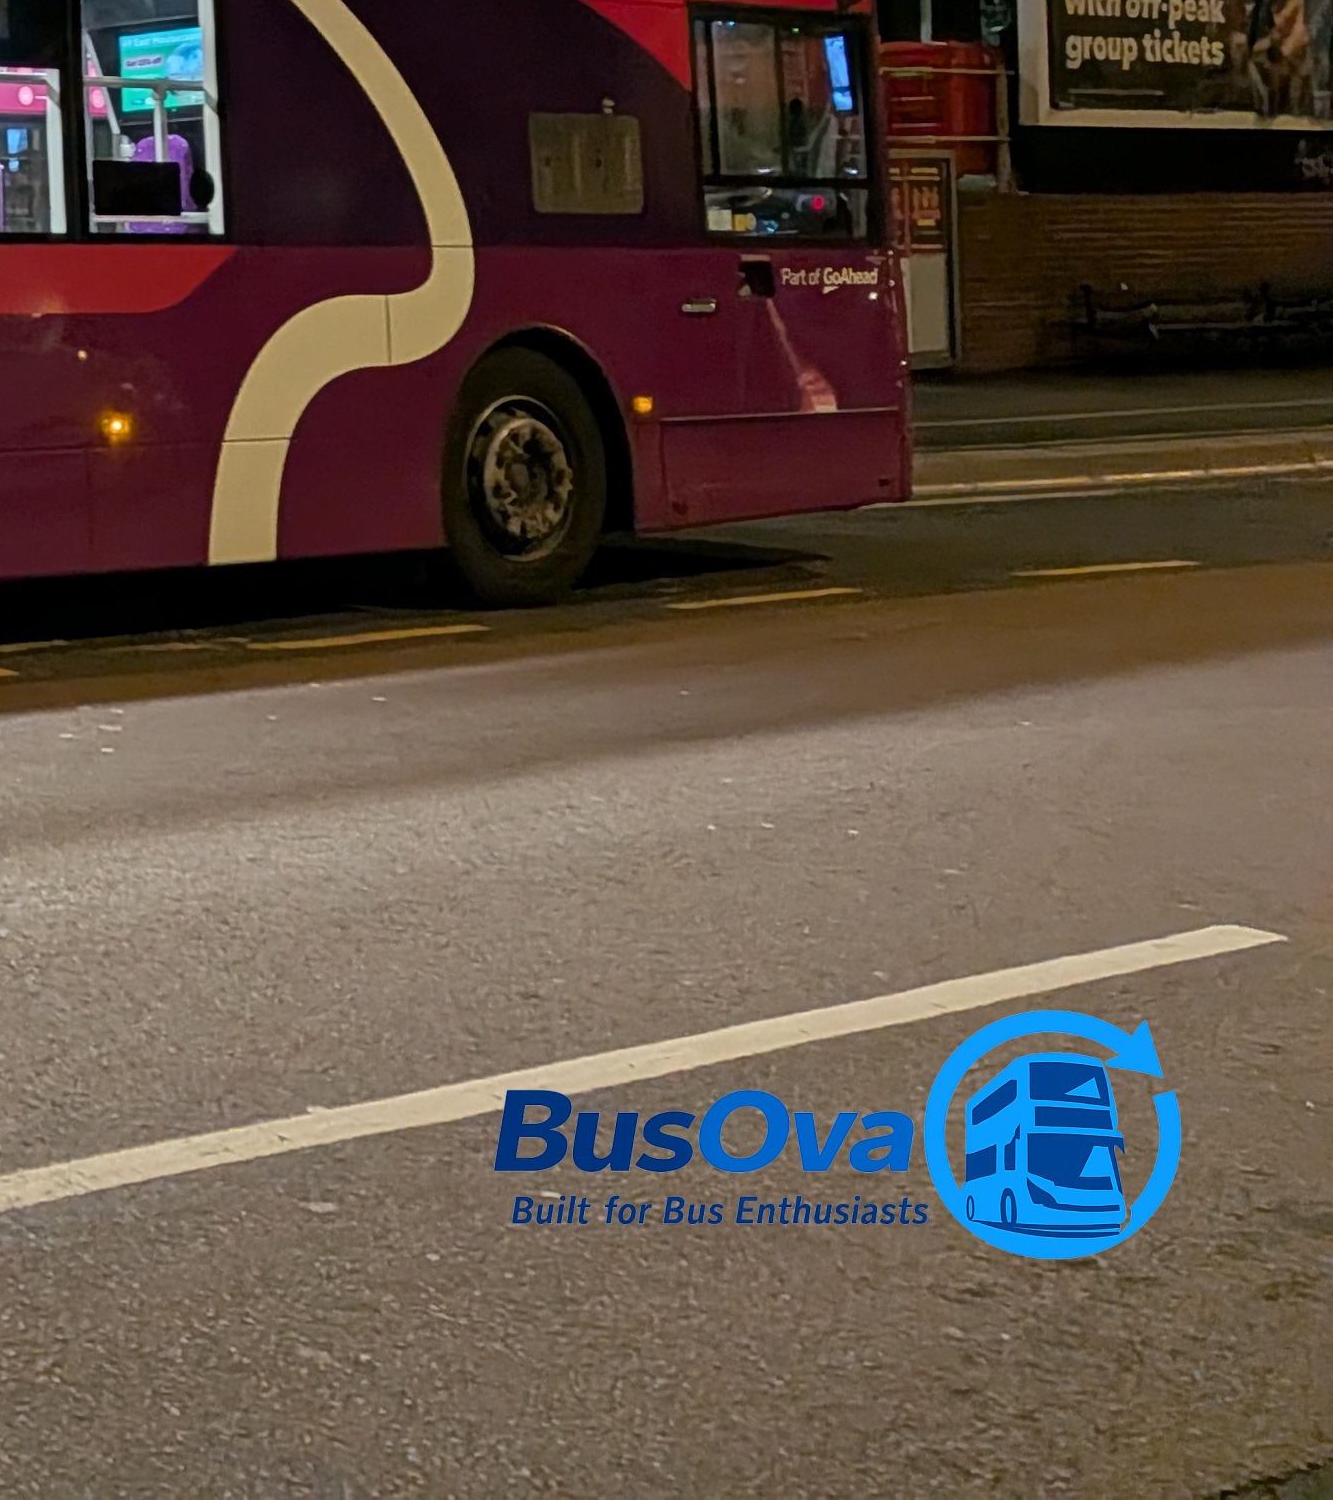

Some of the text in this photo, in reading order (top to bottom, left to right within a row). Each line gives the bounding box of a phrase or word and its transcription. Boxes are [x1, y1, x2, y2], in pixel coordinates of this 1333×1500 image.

[1065, 28, 1226, 71] group tickets
[780, 267, 807, 286] Part
[808, 267, 821, 285] of
